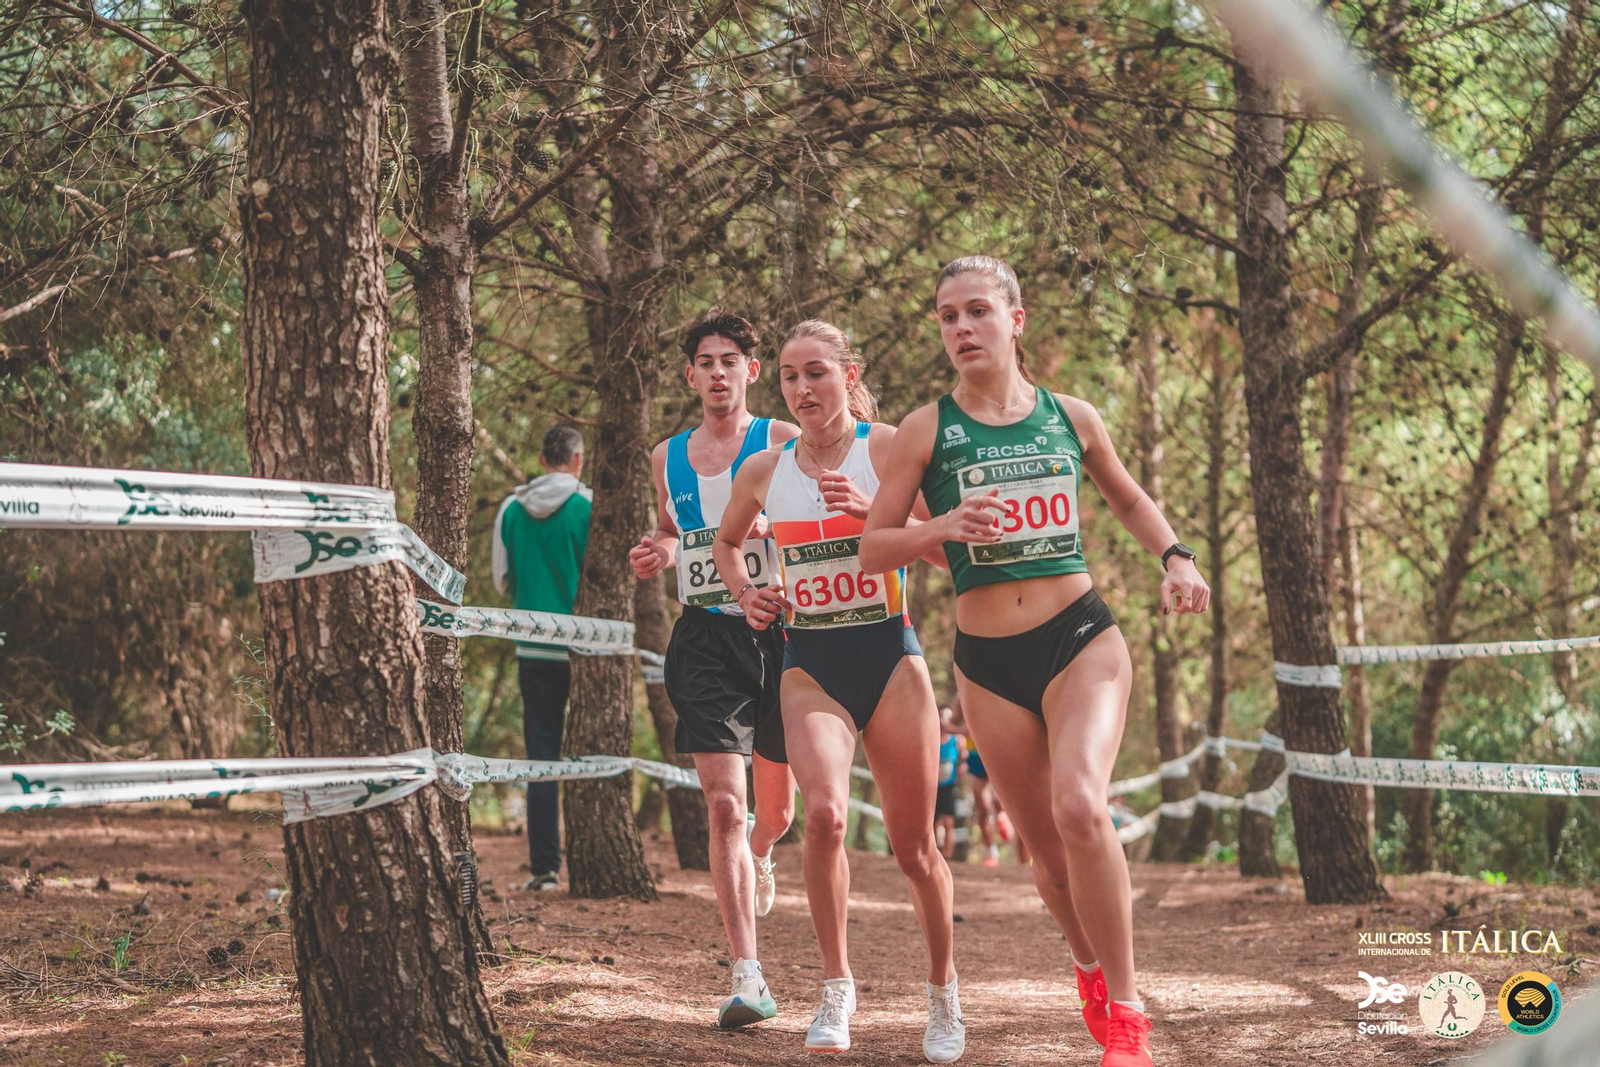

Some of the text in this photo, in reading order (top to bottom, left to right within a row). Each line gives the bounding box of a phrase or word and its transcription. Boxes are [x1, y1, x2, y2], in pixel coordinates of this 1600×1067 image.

[991, 462, 1046, 478] ITÁLICA
[992, 492, 1071, 533] 300
[804, 542, 852, 558] ITÁLICA
[689, 552, 762, 588] 820
[795, 570, 878, 608] 6306
